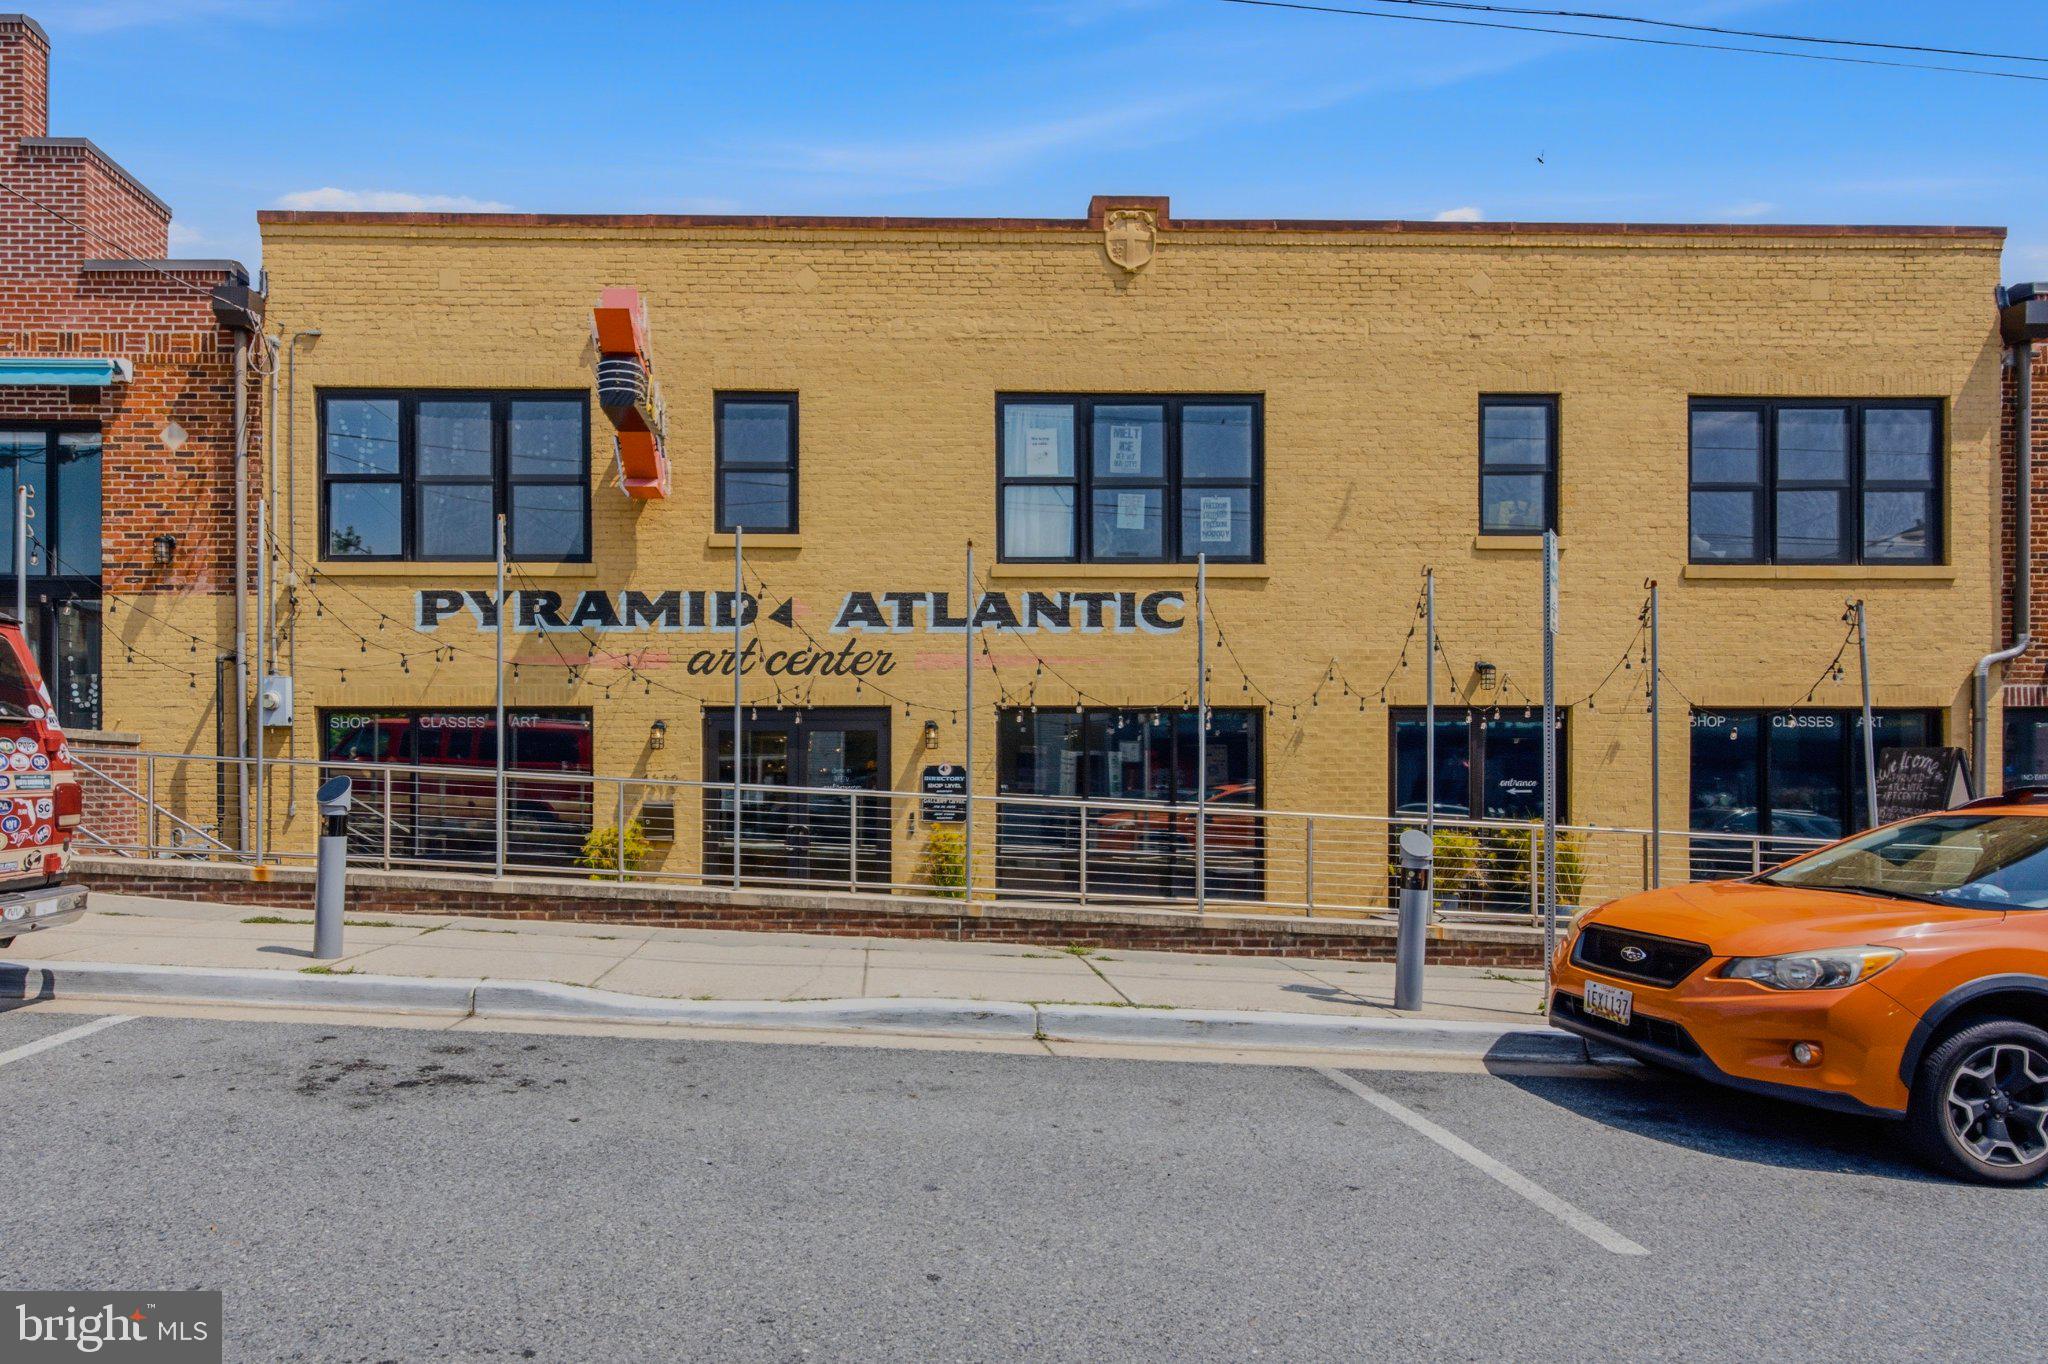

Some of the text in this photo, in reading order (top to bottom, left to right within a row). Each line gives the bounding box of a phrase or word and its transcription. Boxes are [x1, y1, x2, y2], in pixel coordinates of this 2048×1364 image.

[416, 590, 1187, 632] PYRAMID ATLANTIC
[687, 637, 895, 677] art center
[330, 717, 371, 729] SHOP
[420, 716, 486, 729] CLASSES
[511, 716, 538, 728] ART
[1689, 715, 1726, 728] SHOP
[1773, 715, 1834, 728] CLASSES
[1856, 716, 1884, 728] ART
[1500, 778, 1537, 787] entrance
[38, 803, 51, 814] SC
